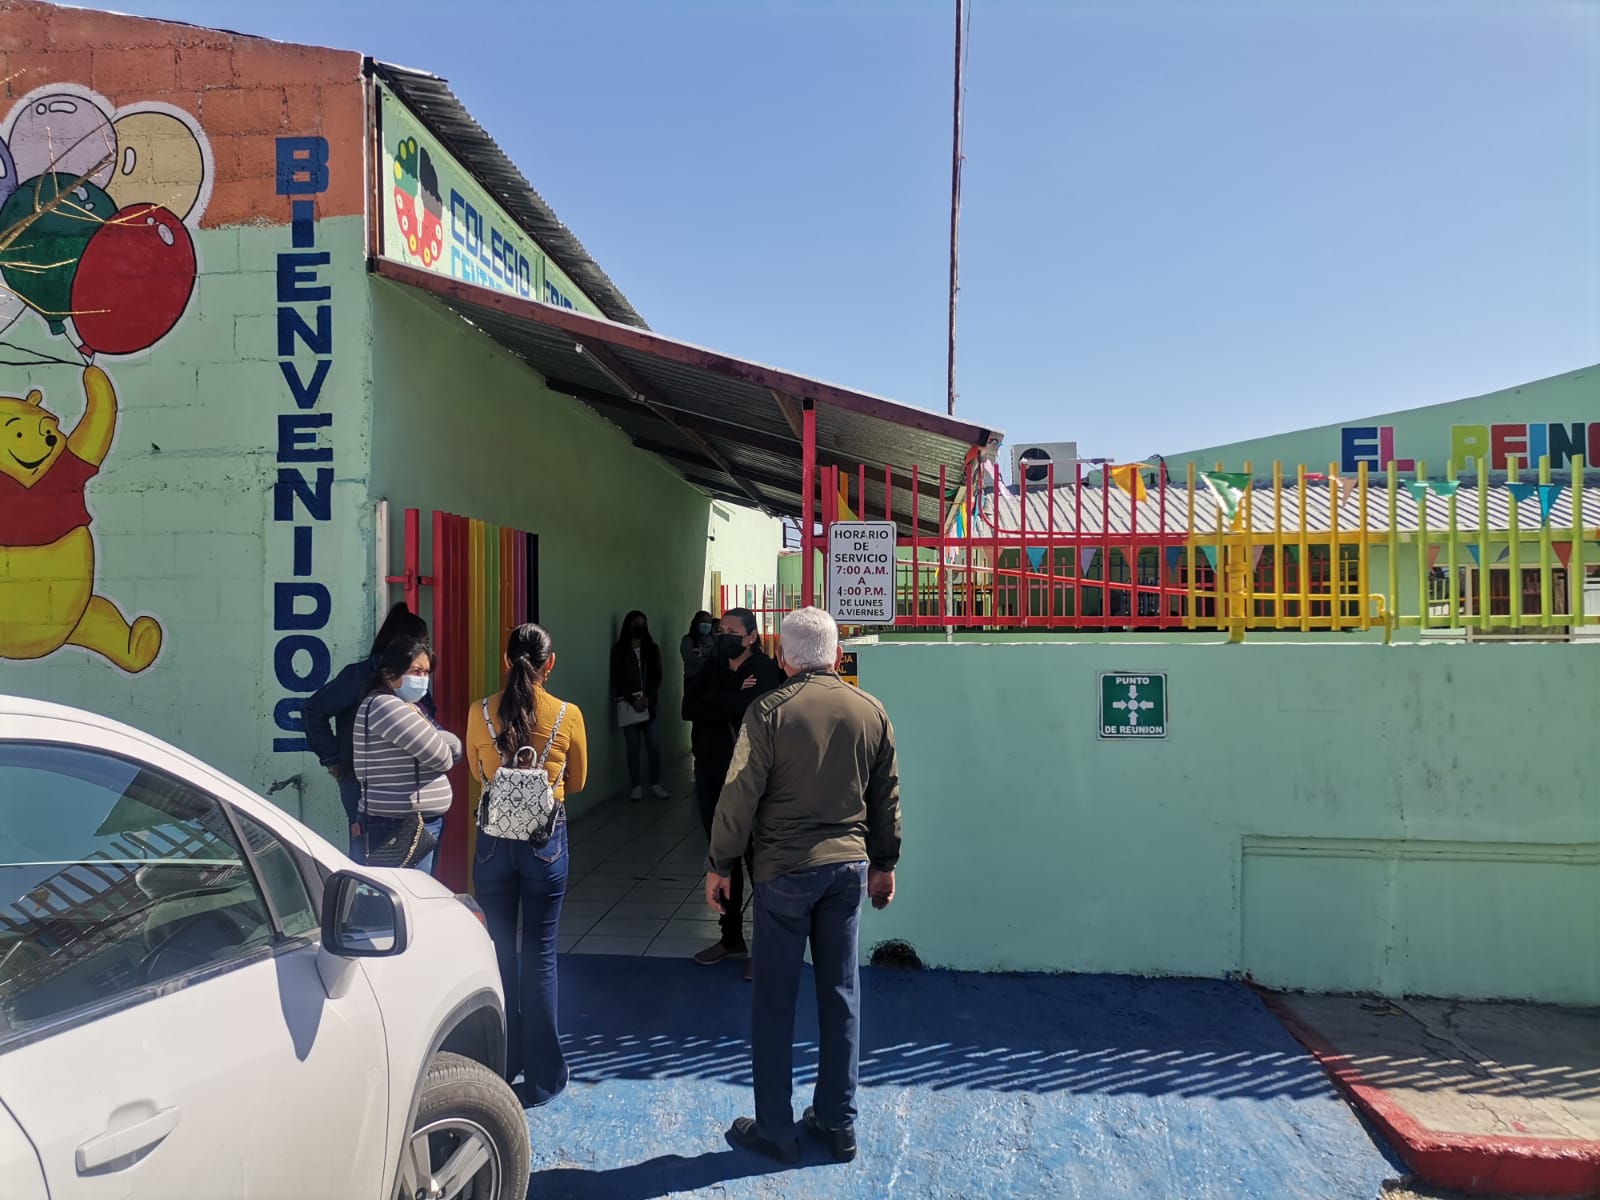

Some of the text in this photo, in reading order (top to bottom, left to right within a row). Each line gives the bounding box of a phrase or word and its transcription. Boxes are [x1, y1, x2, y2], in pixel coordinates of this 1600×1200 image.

[450, 188, 531, 298] COLEGIO
[1341, 426, 1416, 473] EL
[834, 530, 889, 540] HORARIO
[854, 542, 869, 551] DE
[834, 553, 888, 563] SERVICIO
[836, 565, 889, 575] 7:00 A.M.
[857, 576, 866, 585] A
[837, 586, 887, 597] 4:00 P.M.
[839, 599, 883, 607] DE LUNES
[838, 608, 885, 616] A VIERNES
[1115, 677, 1150, 685] PUNTO
[1104, 725, 1163, 734] DE REUNION
